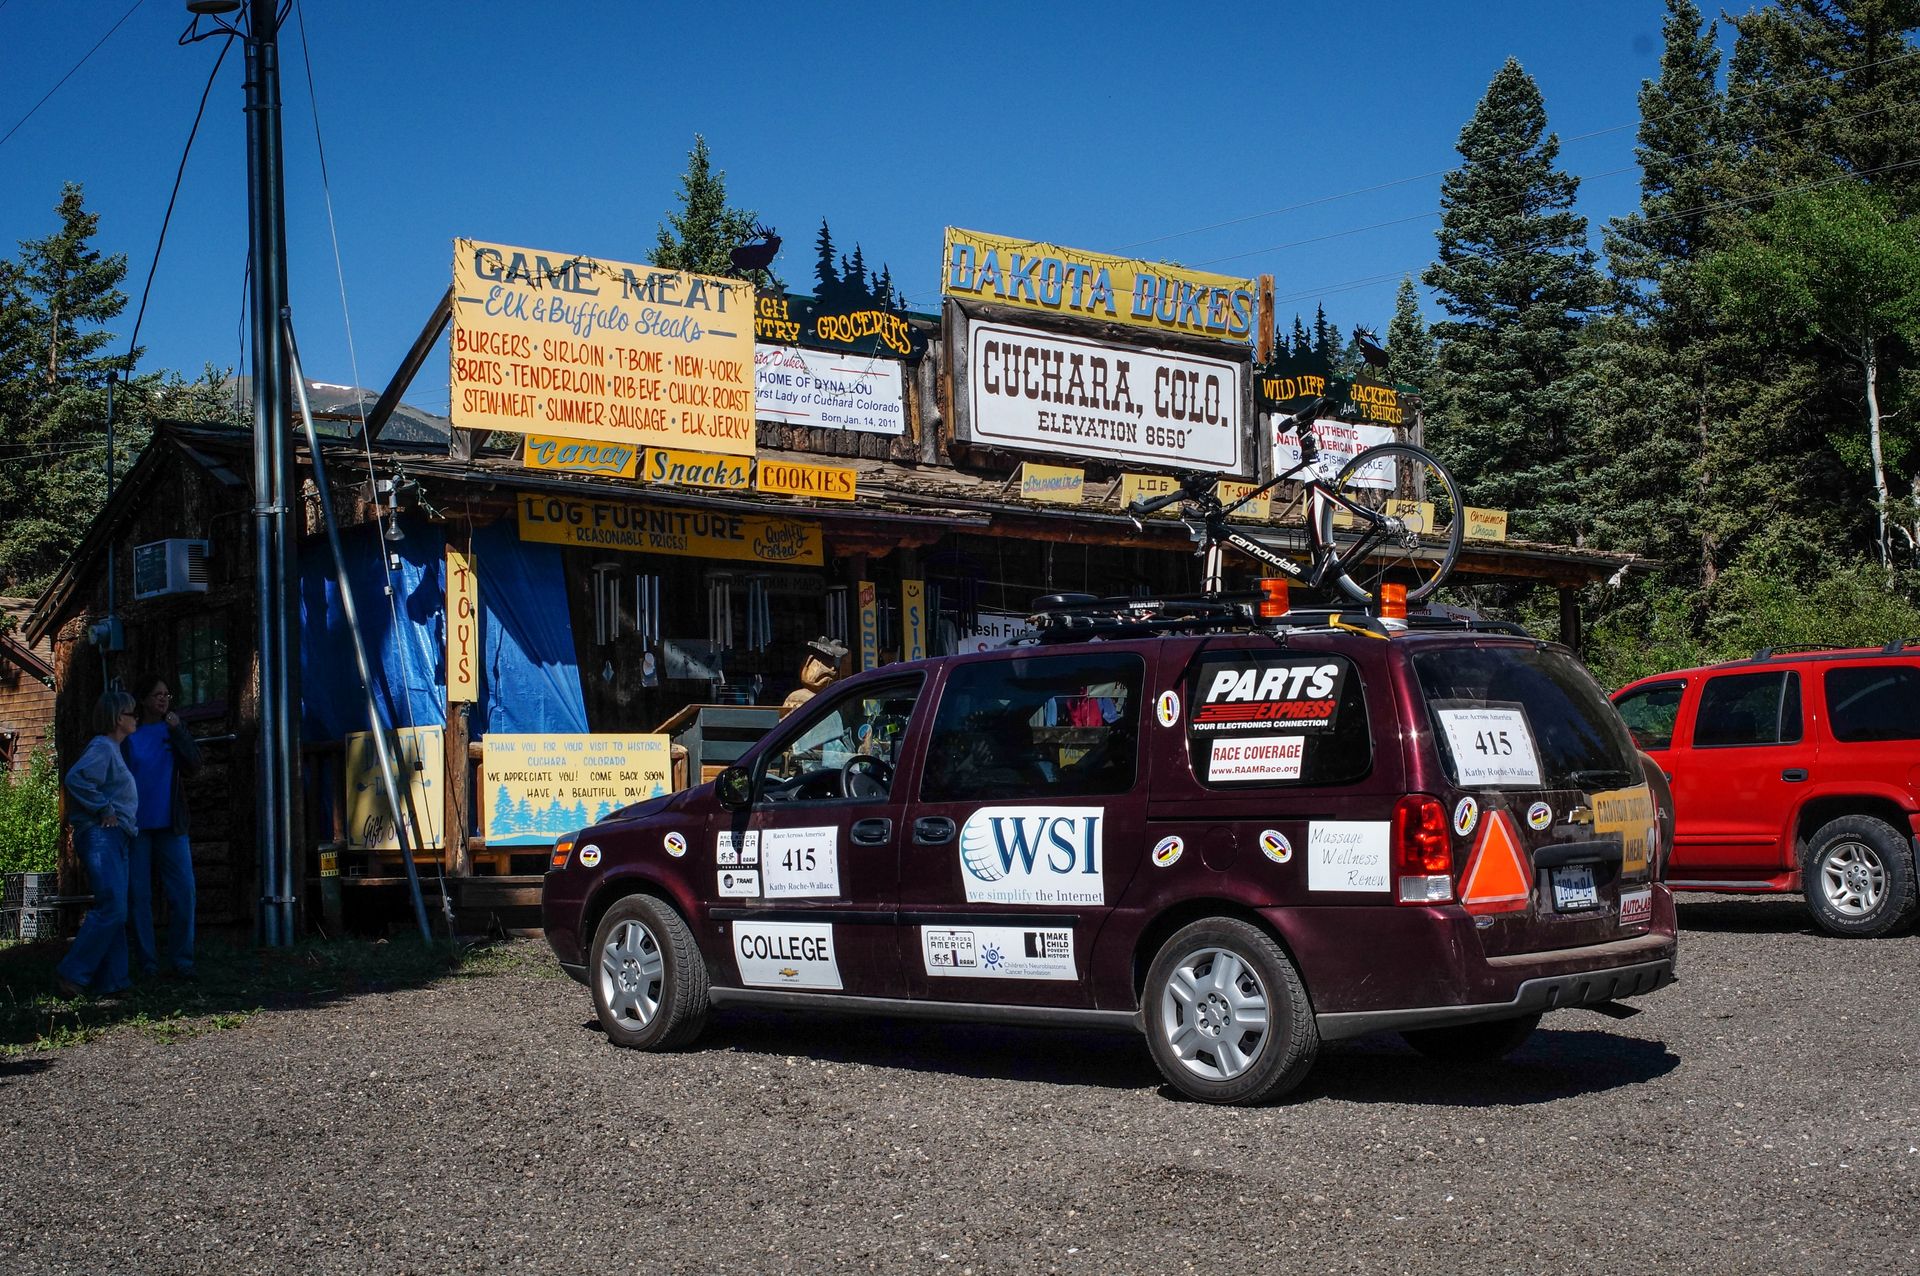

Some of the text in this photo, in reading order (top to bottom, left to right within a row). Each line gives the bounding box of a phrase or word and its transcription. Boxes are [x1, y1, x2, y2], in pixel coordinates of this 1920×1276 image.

[474, 248, 733, 313] GAME MEAT
[950, 243, 1252, 334] DAKOTA DUKES
[485, 285, 704, 343] Elk & Buffalo Steaks
[817, 310, 911, 355] GROCERIES
[456, 328, 531, 359] BURGERS
[543, 339, 604, 367] SIRLOIN
[457, 357, 502, 385] BRATS
[510, 363, 605, 396] TENDERLOIN
[760, 372, 872, 396] HOME OF DYNA LOU
[983, 340, 1228, 427] CUCHARA, COLO.
[775, 388, 797, 405] Lady
[801, 393, 811, 403] of
[813, 394, 853, 409] Cuchara
[856, 398, 900, 413] Colorado
[1262, 378, 1296, 401] WILD
[1350, 384, 1397, 407] JACKETS
[821, 412, 896, 428] Born Jan. 14, 2011
[1340, 402, 1357, 416] And
[1038, 411, 1137, 443] ELEVATION
[1311, 424, 1359, 441] AUTHENTIC
[529, 437, 633, 470] Candy
[652, 452, 745, 485] Snacks
[763, 466, 852, 493] COOKIES
[1137, 477, 1169, 492] LOG
[525, 497, 745, 541] LOG FURNITURE
[576, 527, 688, 550] REASONABLE PRICES!
[765, 522, 810, 549] Quality
[753, 537, 797, 558] Crafted
[1228, 534, 1302, 575] cannondale
[453, 564, 471, 684] TOYS
[1205, 664, 1338, 703] PARTS
[1253, 700, 1336, 720] EXPRESS
[1193, 719, 1329, 730] YOUR ELECTRONICS CONNECTION
[489, 741, 662, 752] THANK YOU FOR YOUR VISIT TO HISTORIC
[1213, 744, 1301, 761] RACE COVERAGE
[1475, 730, 1513, 756] 415
[527, 756, 626, 767] CUCHARA COLORADO
[1211, 764, 1299, 776] www.RAAMRace.org
[1464, 767, 1534, 778] Kathy Roche-Wallace
[487, 771, 665, 782] WE APPRECIATE YOU! COME BACK SOON
[527, 786, 647, 798] HAVE A BEAUTIFUL DAY!
[988, 816, 1100, 875] WSI
[1311, 828, 1364, 848] Massage
[782, 848, 816, 871] 415
[1322, 847, 1378, 866] Wellness
[769, 881, 834, 892] Kathy Roche-Wallace
[1347, 869, 1388, 887] Renew
[968, 889, 1103, 904] we simplify the Internet
[740, 935, 829, 961] COLLEGE
[1046, 933, 1068, 941] MAKE
